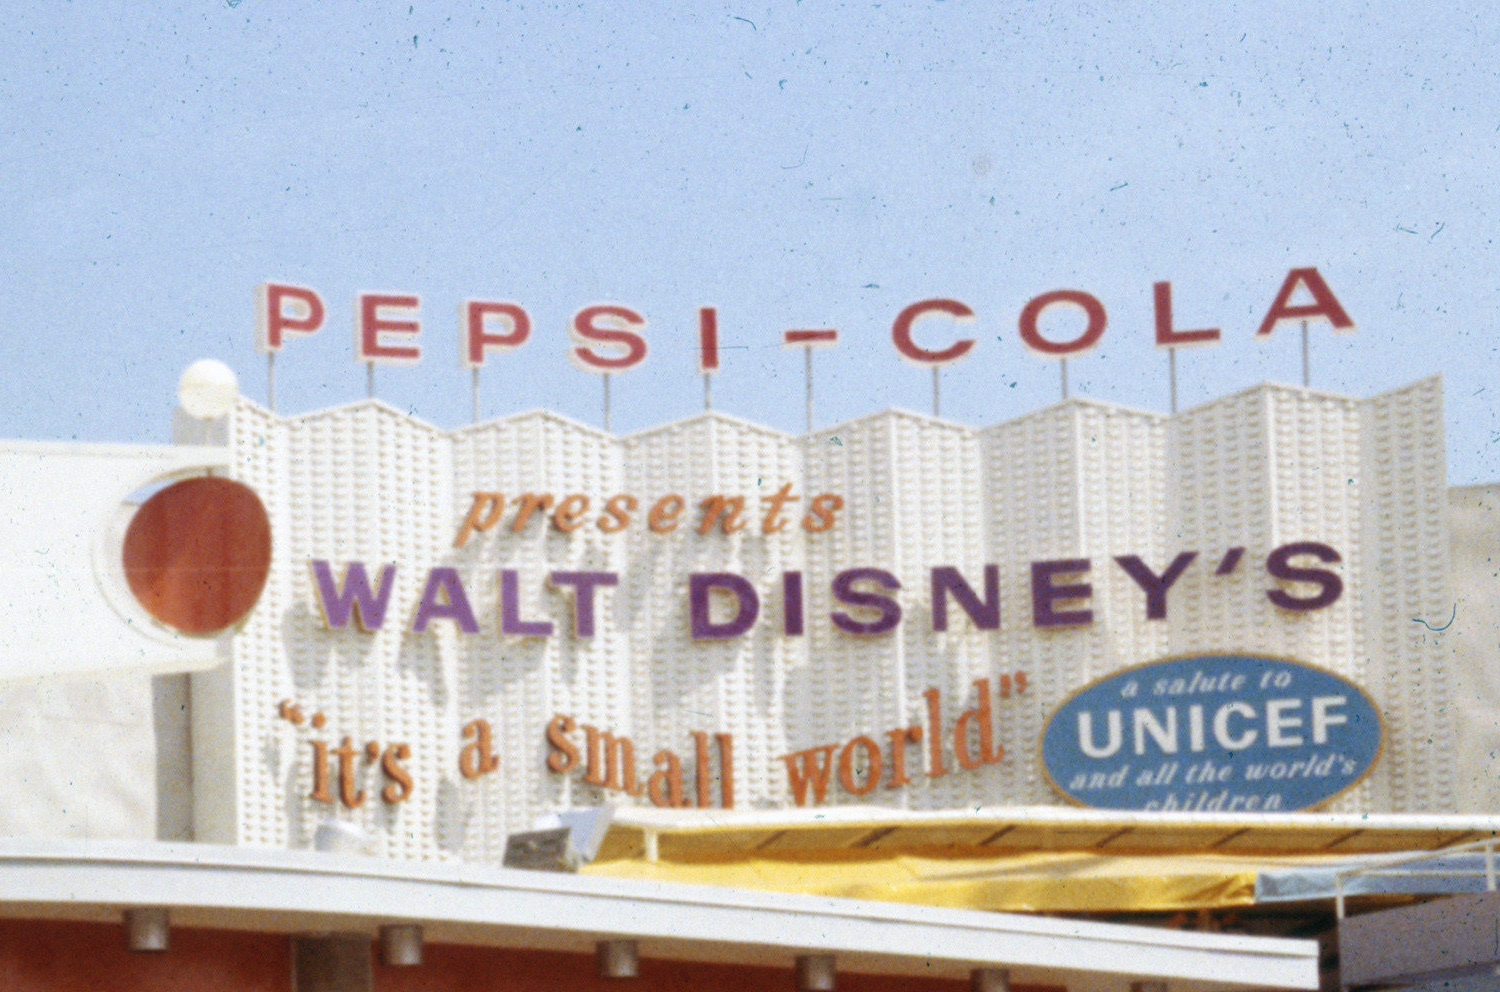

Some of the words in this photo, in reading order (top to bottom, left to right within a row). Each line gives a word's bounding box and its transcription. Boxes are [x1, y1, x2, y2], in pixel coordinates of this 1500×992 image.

[264, 266, 1356, 370] PEPSI-COLA
[452, 482, 844, 548] presents
[311, 558, 619, 638] WALT
[688, 541, 1344, 640] DISNEY'S
[1120, 678, 1139, 698] a
[1153, 671, 1247, 696] salute
[1259, 670, 1293, 689] to
[279, 698, 414, 809] “it's
[459, 718, 500, 780] a
[546, 713, 734, 810] small
[777, 670, 1028, 808] world”
[1077, 695, 1348, 759] UNICEF
[1069, 764, 1131, 791] and
[1135, 762, 1178, 787] all
[1185, 760, 1233, 785] the
[1244, 754, 1358, 781] world's
